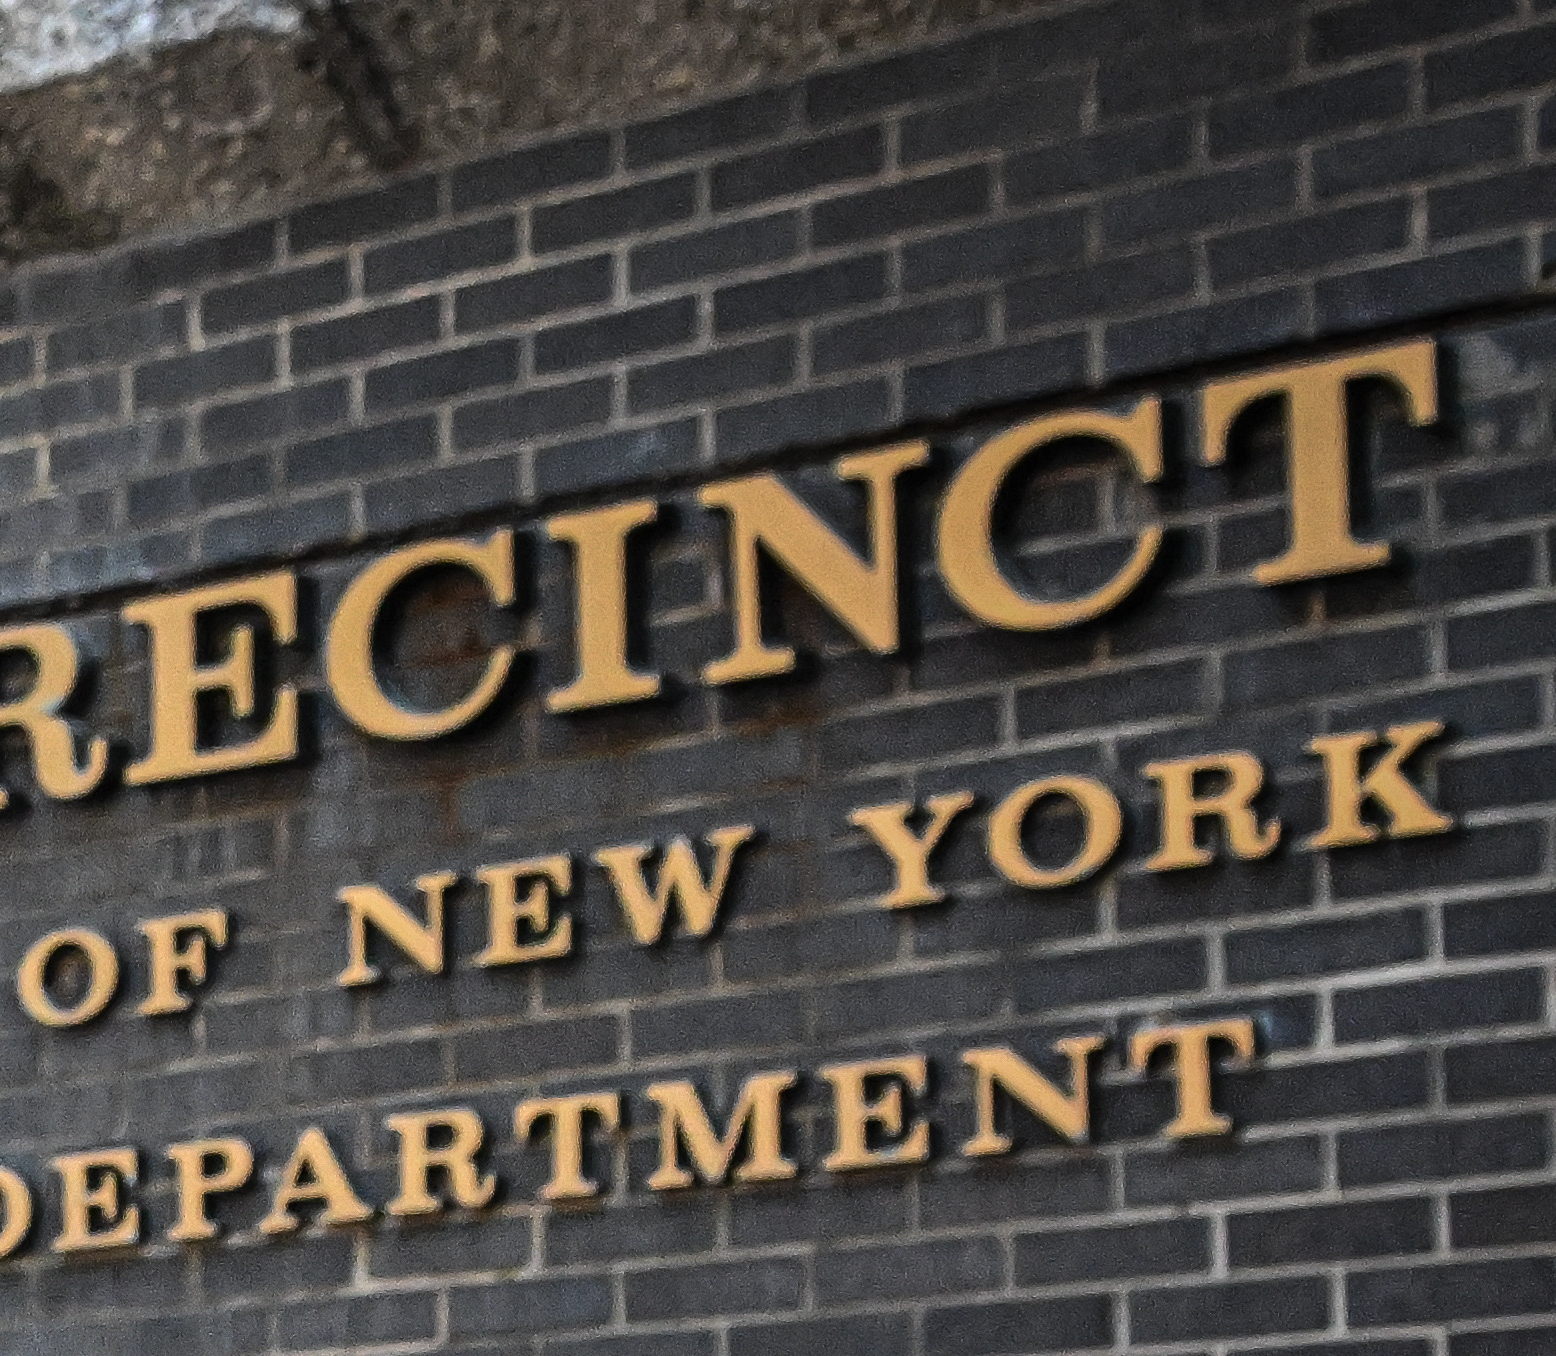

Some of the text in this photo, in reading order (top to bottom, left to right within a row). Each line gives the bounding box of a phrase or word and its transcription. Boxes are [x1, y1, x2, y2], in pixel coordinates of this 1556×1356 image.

[18, 909, 228, 1026] OF
[338, 826, 753, 986] NEW
[850, 721, 1450, 909] YORK
